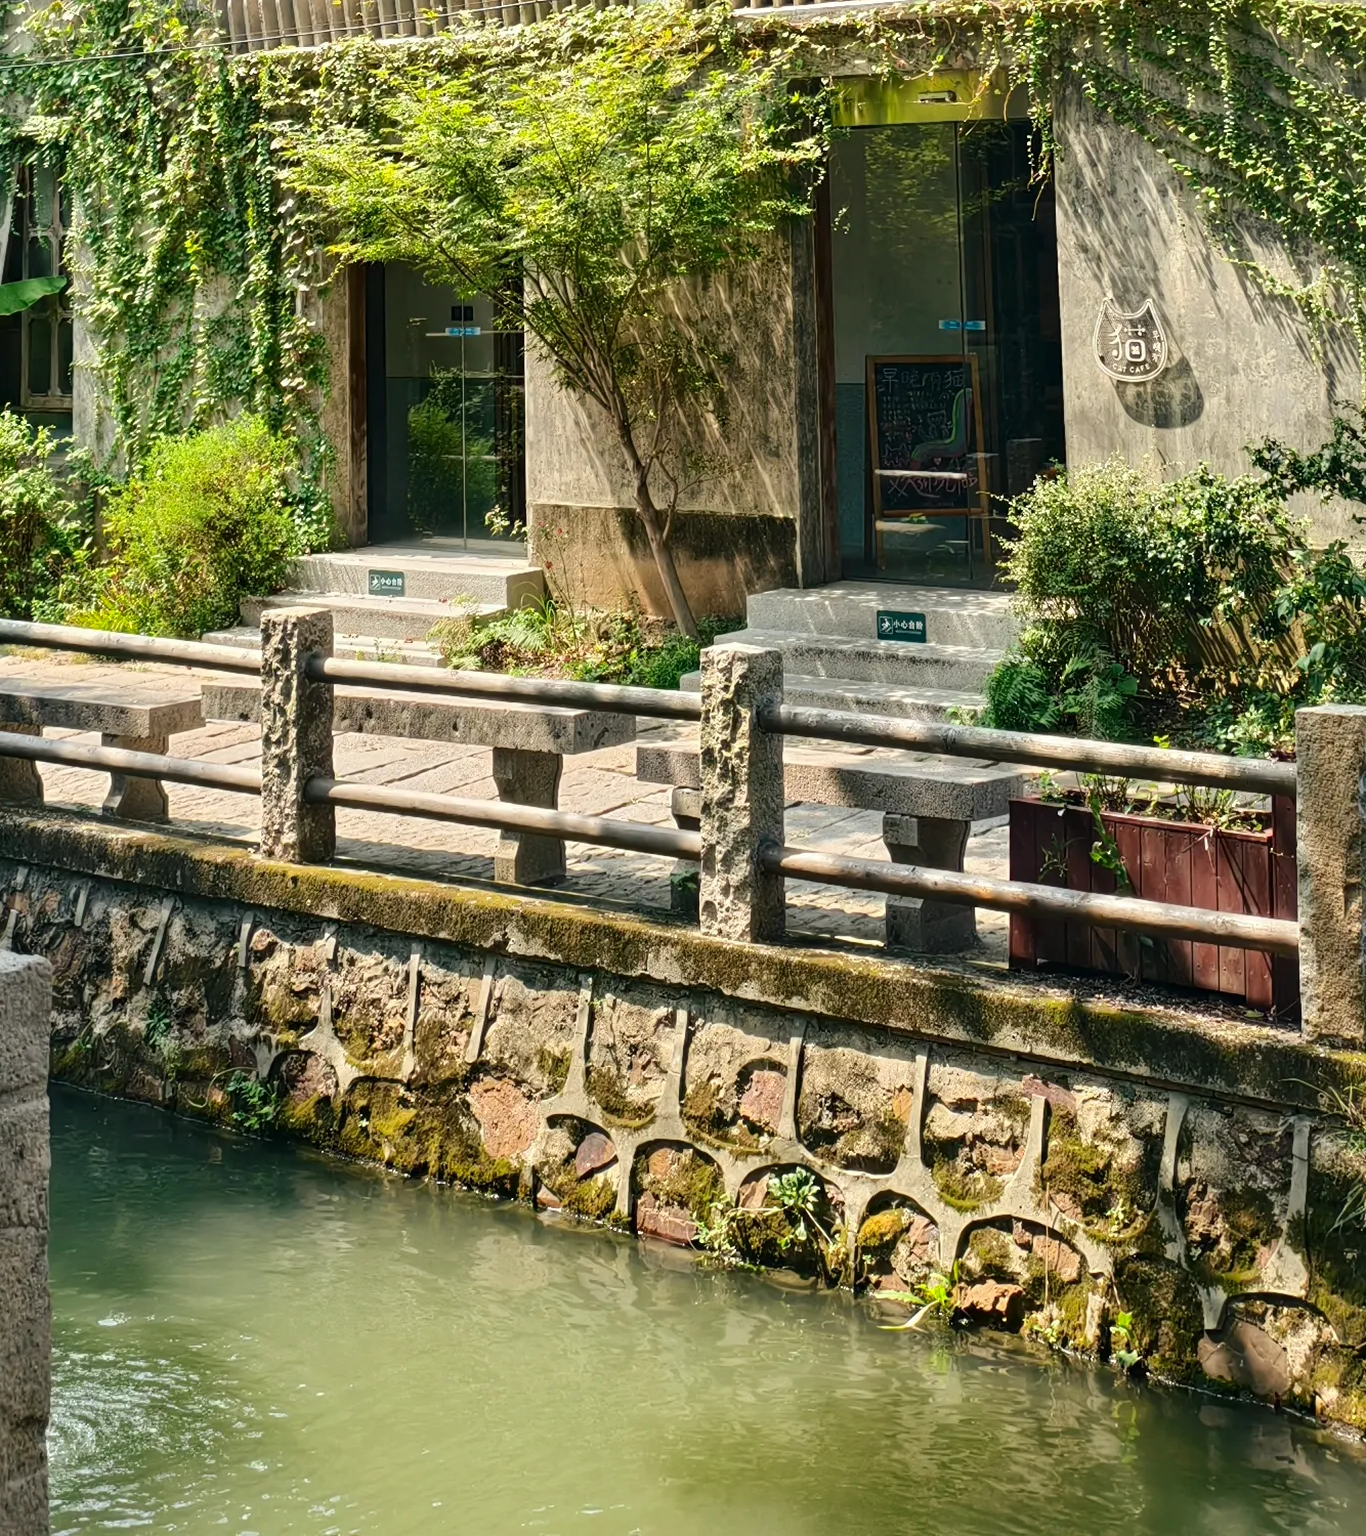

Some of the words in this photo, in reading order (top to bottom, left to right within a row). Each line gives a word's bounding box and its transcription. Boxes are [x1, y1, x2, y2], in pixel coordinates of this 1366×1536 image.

[1112, 363, 1127, 373] CAT
[1129, 363, 1151, 374] CAFE
[893, 619, 923, 630] 小心台阶
